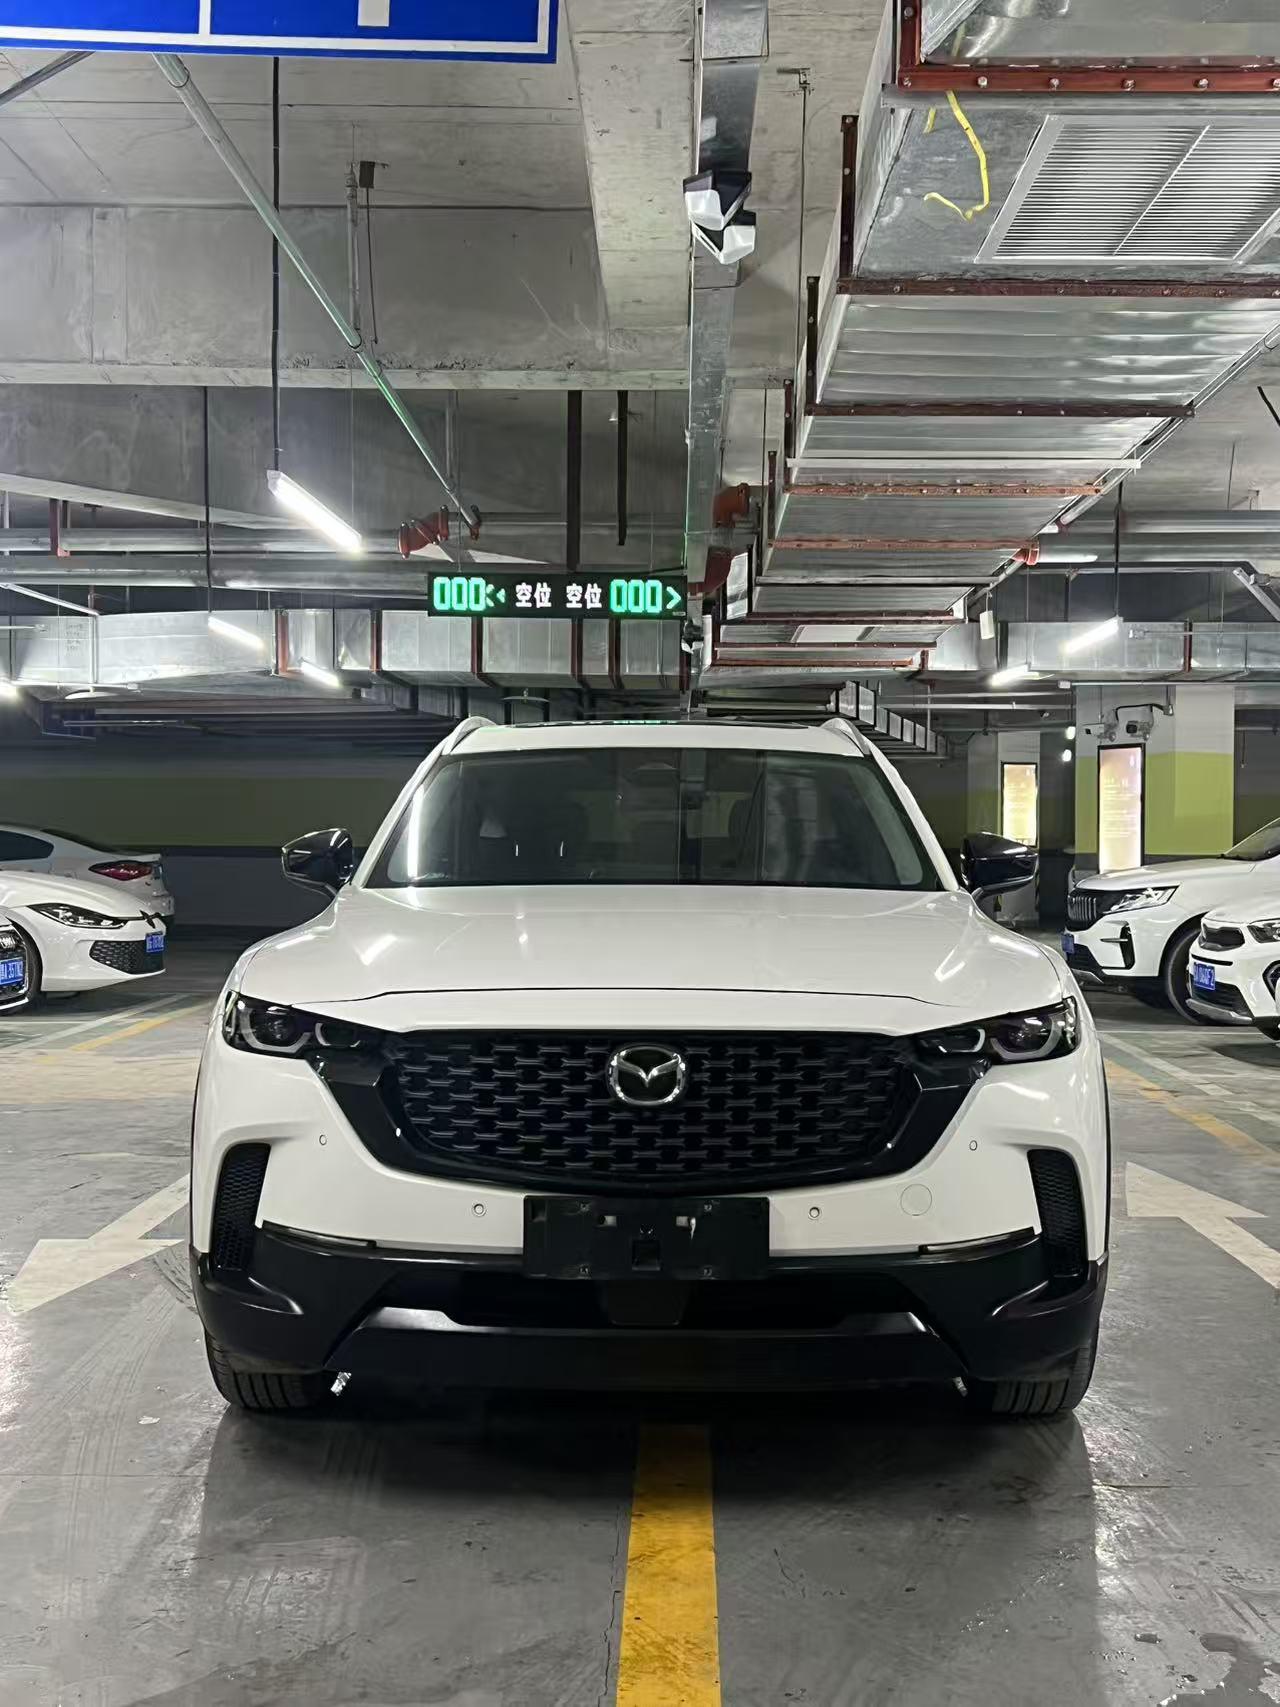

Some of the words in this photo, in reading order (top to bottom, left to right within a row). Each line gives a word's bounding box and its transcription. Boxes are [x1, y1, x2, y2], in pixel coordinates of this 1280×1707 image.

[433, 576, 486, 612] 000
[515, 582, 552, 608] 空位
[566, 583, 602, 609] 空位
[610, 579, 663, 614] 000
